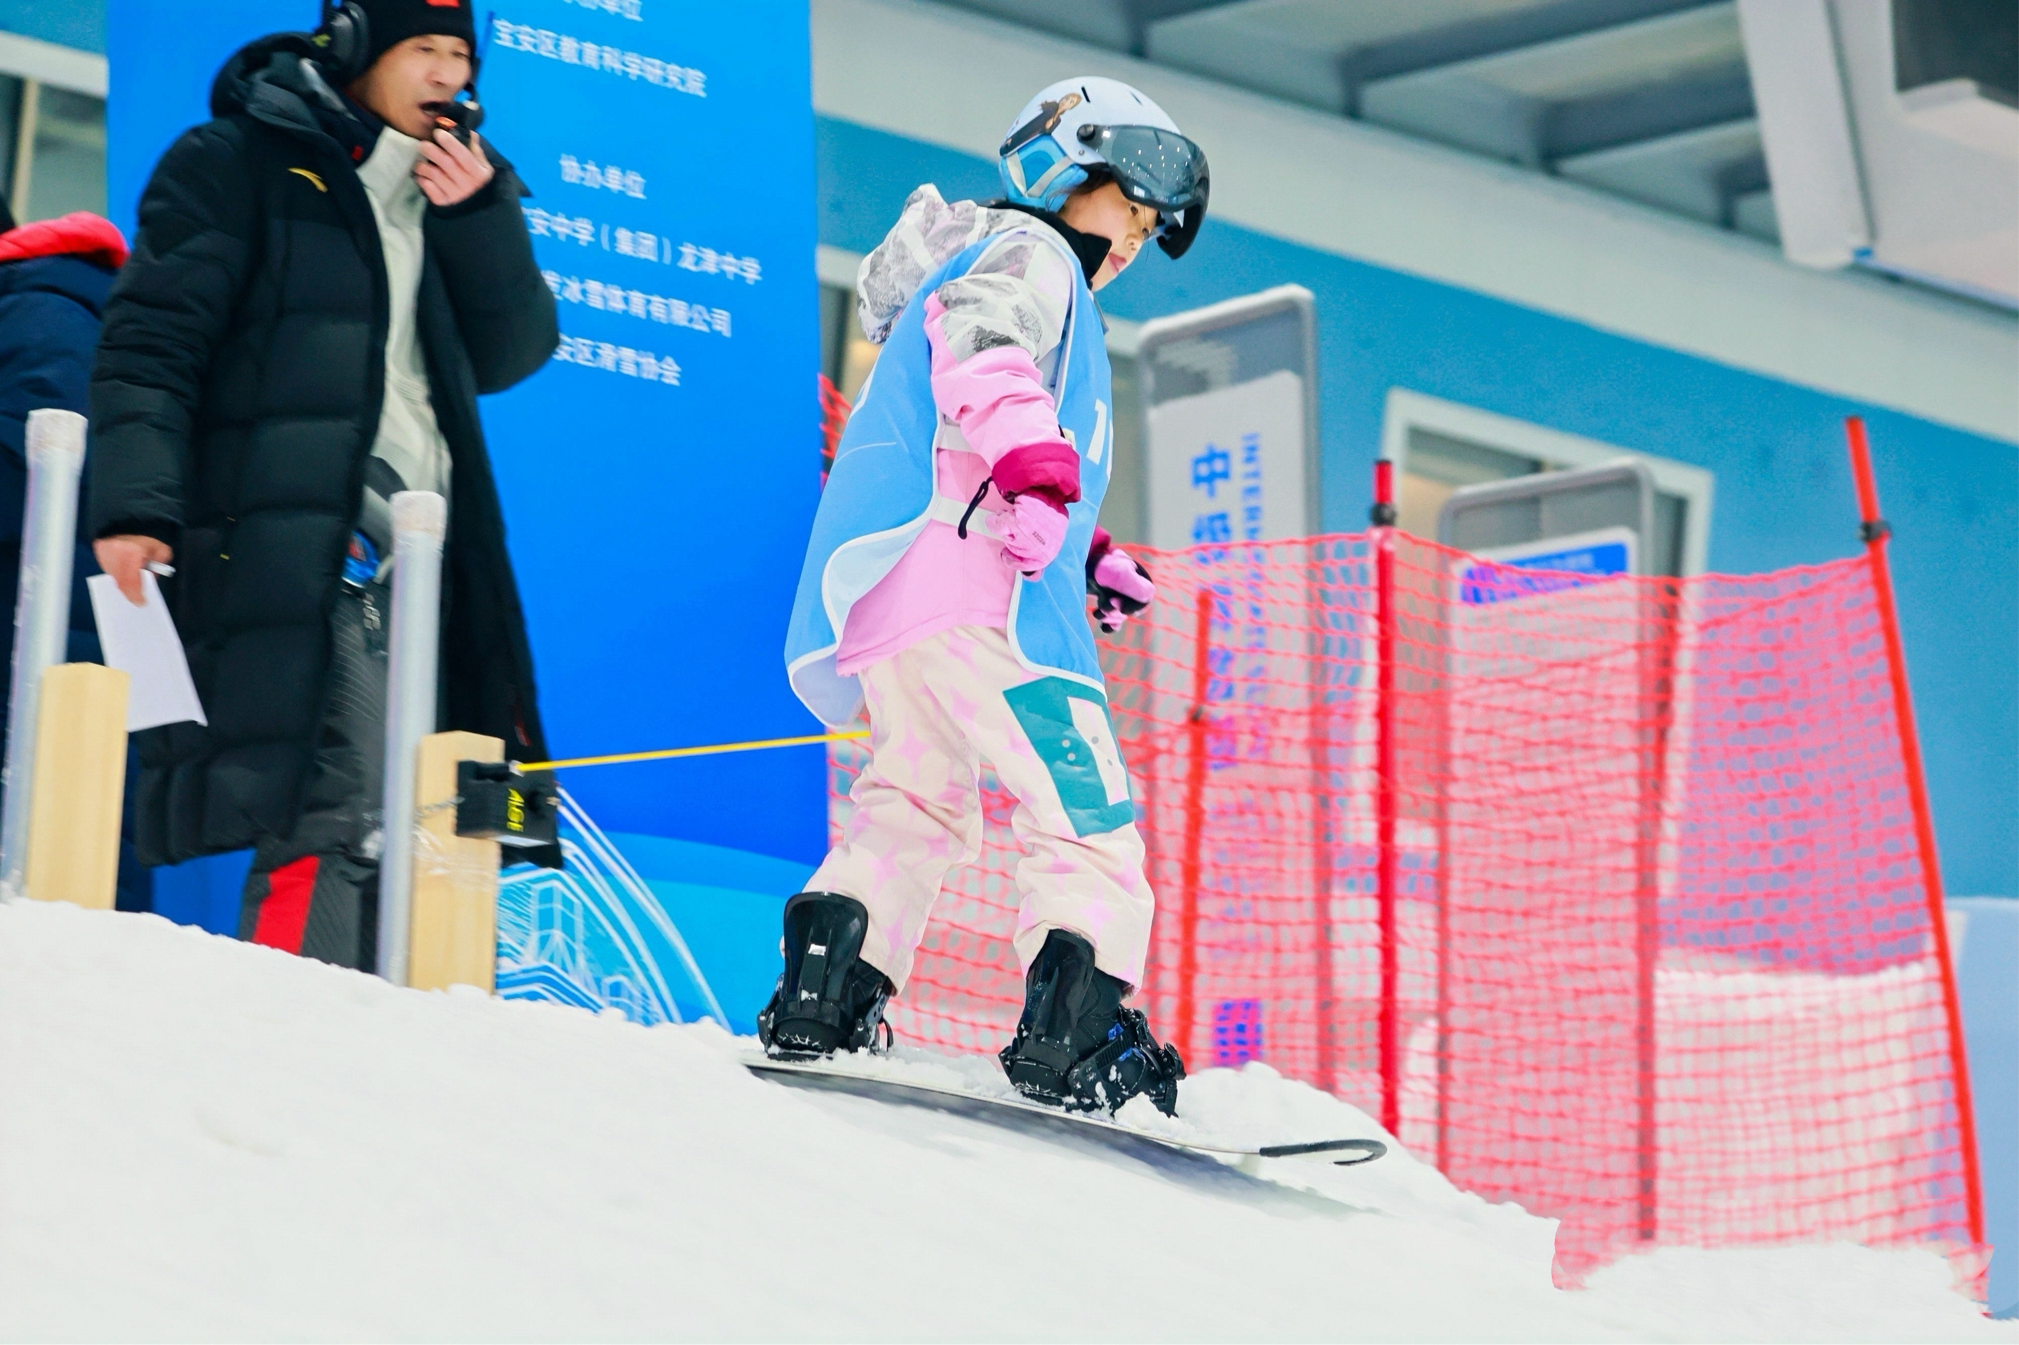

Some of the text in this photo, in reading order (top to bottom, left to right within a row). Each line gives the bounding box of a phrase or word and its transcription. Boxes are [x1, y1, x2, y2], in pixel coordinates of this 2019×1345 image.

[559, 153, 647, 199] 协办单位
[521, 205, 762, 285] 安中学（集团）龙津中学
